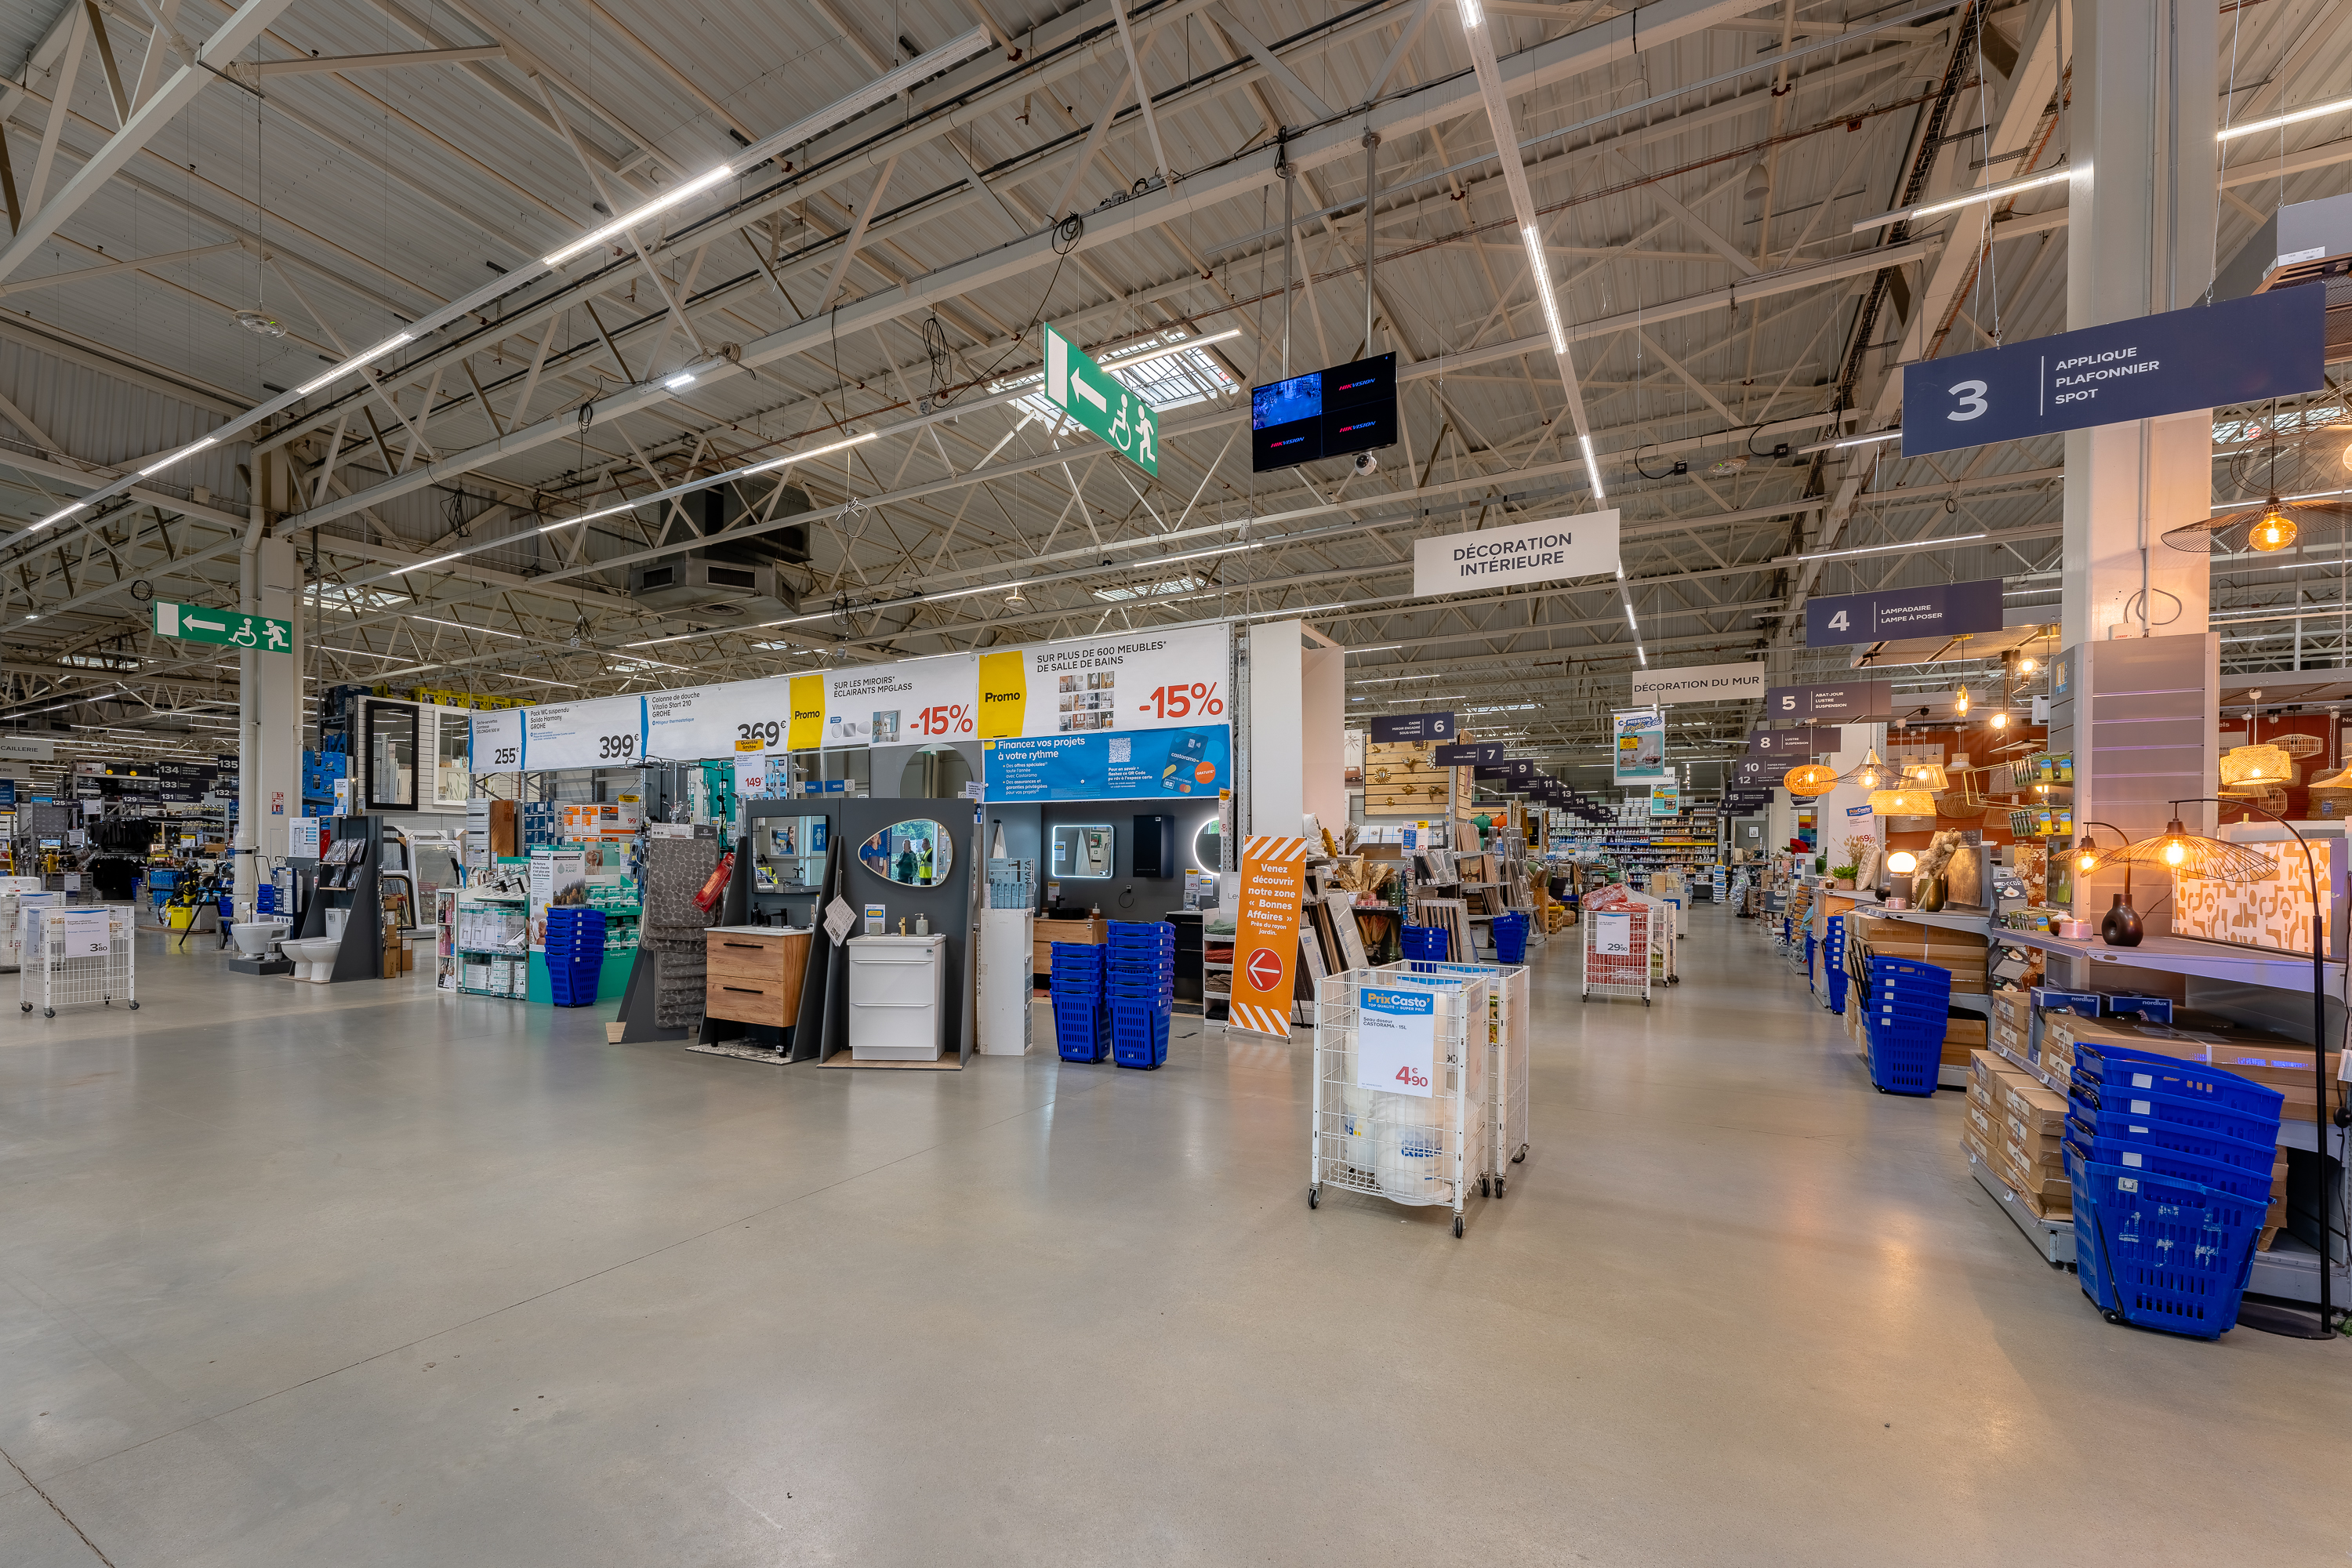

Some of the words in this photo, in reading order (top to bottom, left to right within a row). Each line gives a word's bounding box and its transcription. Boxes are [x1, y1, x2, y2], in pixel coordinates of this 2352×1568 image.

[2055, 347, 2137, 372] APPLIQUE
[2055, 360, 2160, 388] PLAFONNIER
[1339, 378, 1375, 390] HIKVISION
[1947, 379, 1988, 422] 3
[2055, 389, 2099, 405] SPOT
[1339, 420, 1376, 433] HIKVISION
[1270, 436, 1305, 448] HIKVISION
[1454, 532, 1572, 561] DÉCORATION
[1461, 550, 1564, 577] INTÉRIEURE
[1882, 605, 1931, 615] LAMPADAIRE
[1828, 610, 1850, 631] 4
[1036, 654, 1055, 663] SUR
[1058, 652, 1080, 662] PLUS
[1082, 650, 1095, 659] DE
[1097, 648, 1115, 658] 600
[1051, 662, 1078, 671] SALLE
[1080, 659, 1093, 669] DE
[1094, 656, 1123, 667] BAINS
[834, 681, 848, 690] SUR
[850, 680, 862, 688] LES
[834, 685, 876, 698] ÉCLAIRANTS
[878, 683, 913, 694] MPGLASS
[1634, 681, 1708, 692] DÉCORATION
[1733, 677, 1759, 685] MUR
[652, 694, 673, 703] Colonne
[681, 691, 700, 700] douche
[985, 691, 1021, 703] Promo
[1139, 681, 1223, 719] -15%
[1782, 696, 1796, 710] 5
[549, 707, 570, 716] suspendu
[795, 710, 820, 720] Promo
[910, 703, 973, 736] -15%
[1434, 720, 1445, 733] 6
[599, 734, 639, 759] 399€
[998, 740, 1036, 750] Financez
[1054, 737, 1085, 749] projets
[1760, 737, 1771, 749] 8
[495, 746, 520, 765] 255€
[998, 752, 1004, 760] à
[1029, 750, 1059, 760] rythme
[1171, 753, 1196, 762] castorama
[1487, 750, 1496, 760] 7
[219, 760, 238, 768] 135
[1519, 764, 1527, 773] 9
[1745, 763, 1759, 772] 10
[1261, 864, 1288, 873] Venez
[1252, 876, 1294, 886] découvrir
[1248, 887, 1273, 897] notre
[1274, 890, 1296, 898] zone
[1259, 899, 1293, 911] Bonnes
[1247, 909, 1283, 922] Affaires
[1368, 993, 1430, 1007] PrixCasto'
